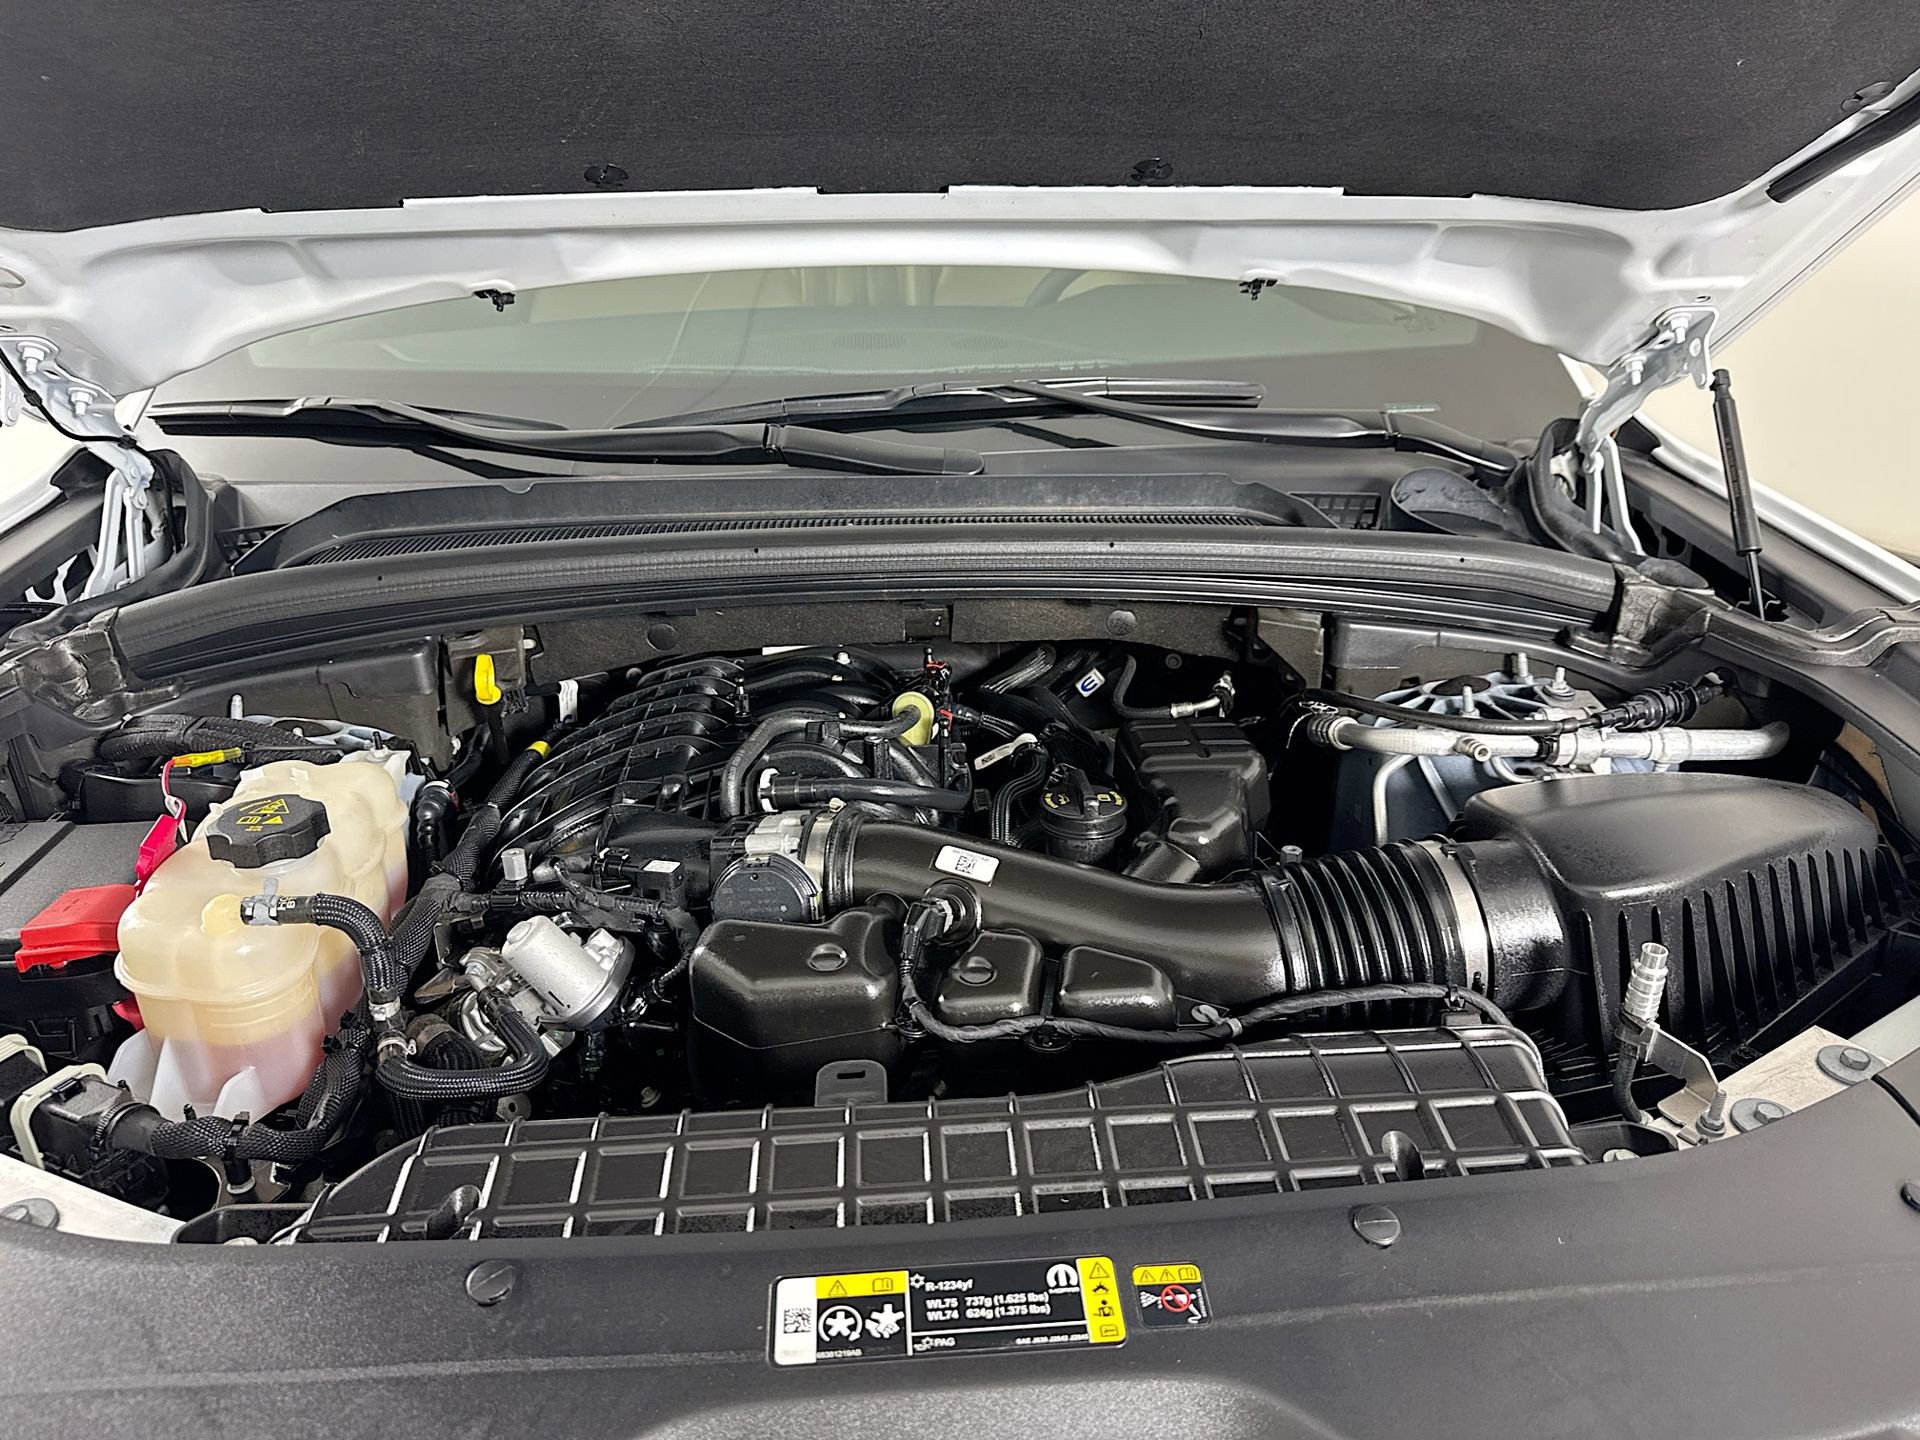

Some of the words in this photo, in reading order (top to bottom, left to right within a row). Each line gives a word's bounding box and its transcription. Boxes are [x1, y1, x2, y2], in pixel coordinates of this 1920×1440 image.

[925, 1279, 973, 1292] R-1234yf
[926, 1298, 958, 1310] WL75
[965, 1296, 993, 1308] 737g
[994, 1293, 1027, 1306] (1.625
[1028, 1292, 1049, 1303] lbs)
[927, 1310, 959, 1321] WL74
[966, 1308, 993, 1320] 624g
[995, 1305, 1028, 1318] (1.375
[1029, 1304, 1051, 1315] lbs)
[934, 1337, 956, 1347] PAG
